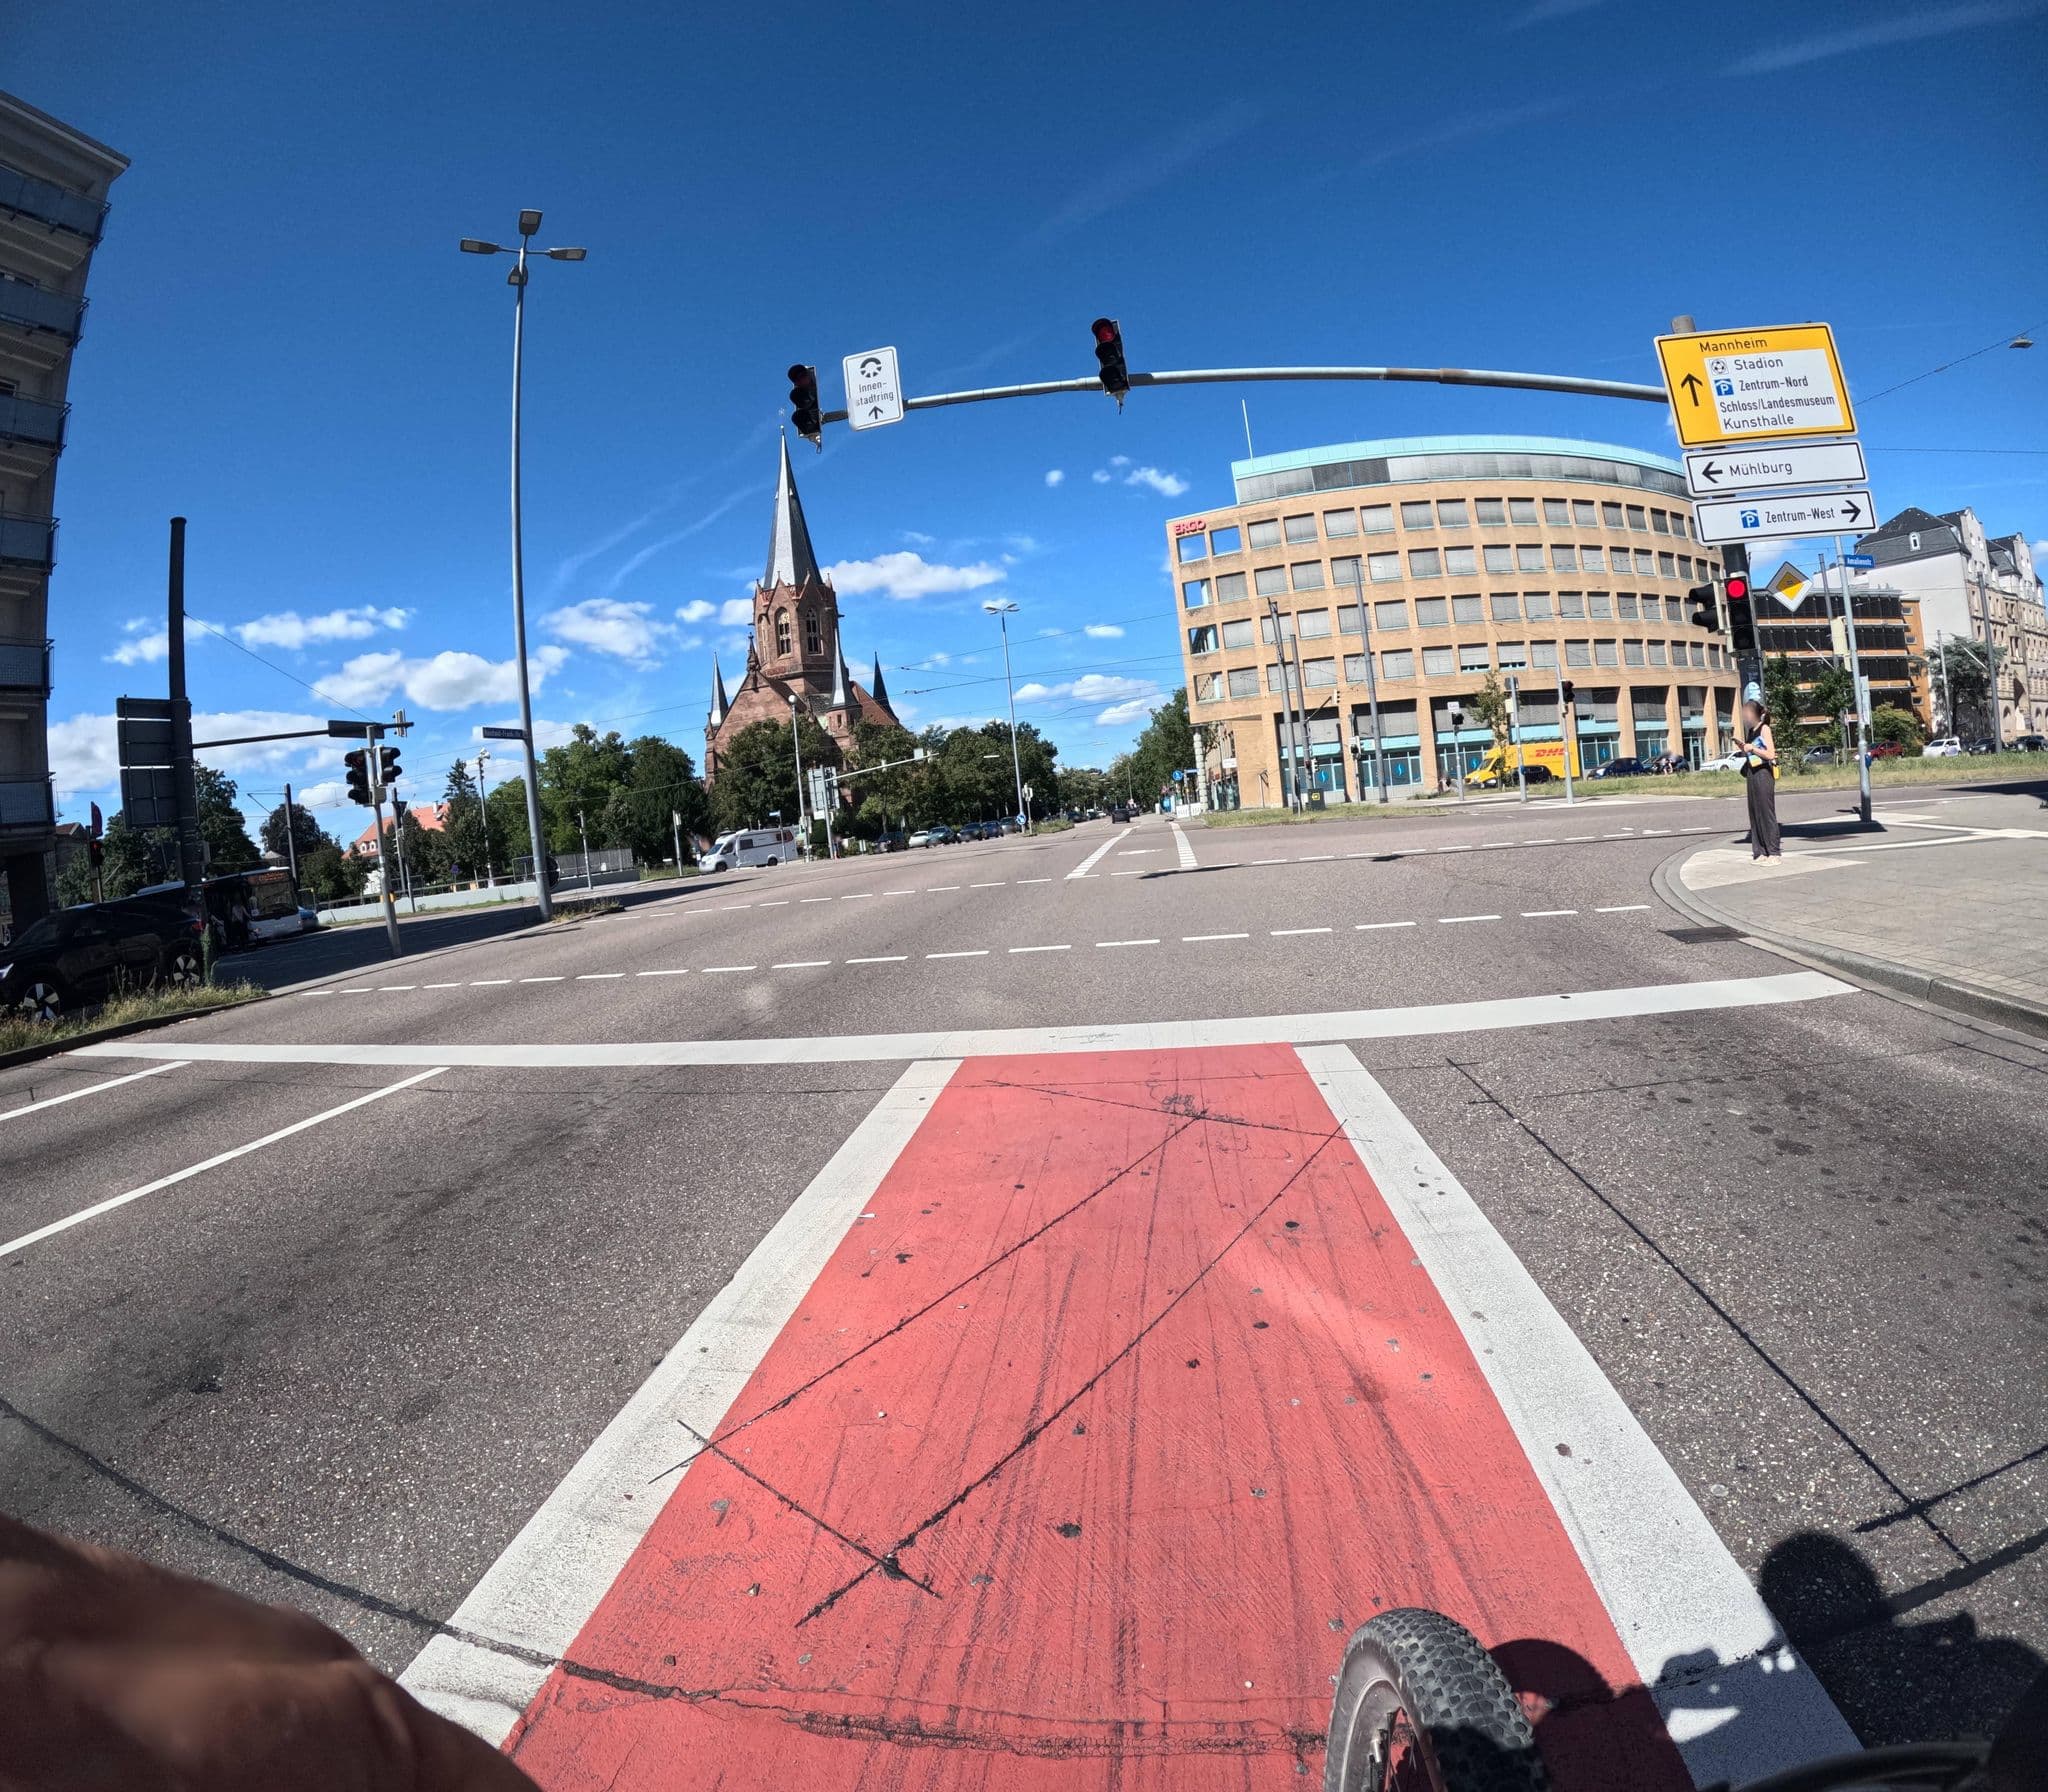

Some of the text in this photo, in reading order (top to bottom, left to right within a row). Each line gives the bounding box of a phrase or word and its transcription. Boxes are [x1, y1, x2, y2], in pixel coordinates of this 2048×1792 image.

[1699, 337, 1768, 352] Mannheim
[1734, 357, 1784, 371] Stadion
[859, 381, 887, 393] Innen-
[1739, 375, 1809, 392] Zentrum-Nord
[1719, 394, 1835, 413] Schloss/Landesmuseum
[1723, 414, 1794, 430] Kunsthalle
[1729, 461, 1793, 477] Mühlburg
[1765, 507, 1835, 525] Zentrum-West
[1174, 520, 1206, 536] ERGO
